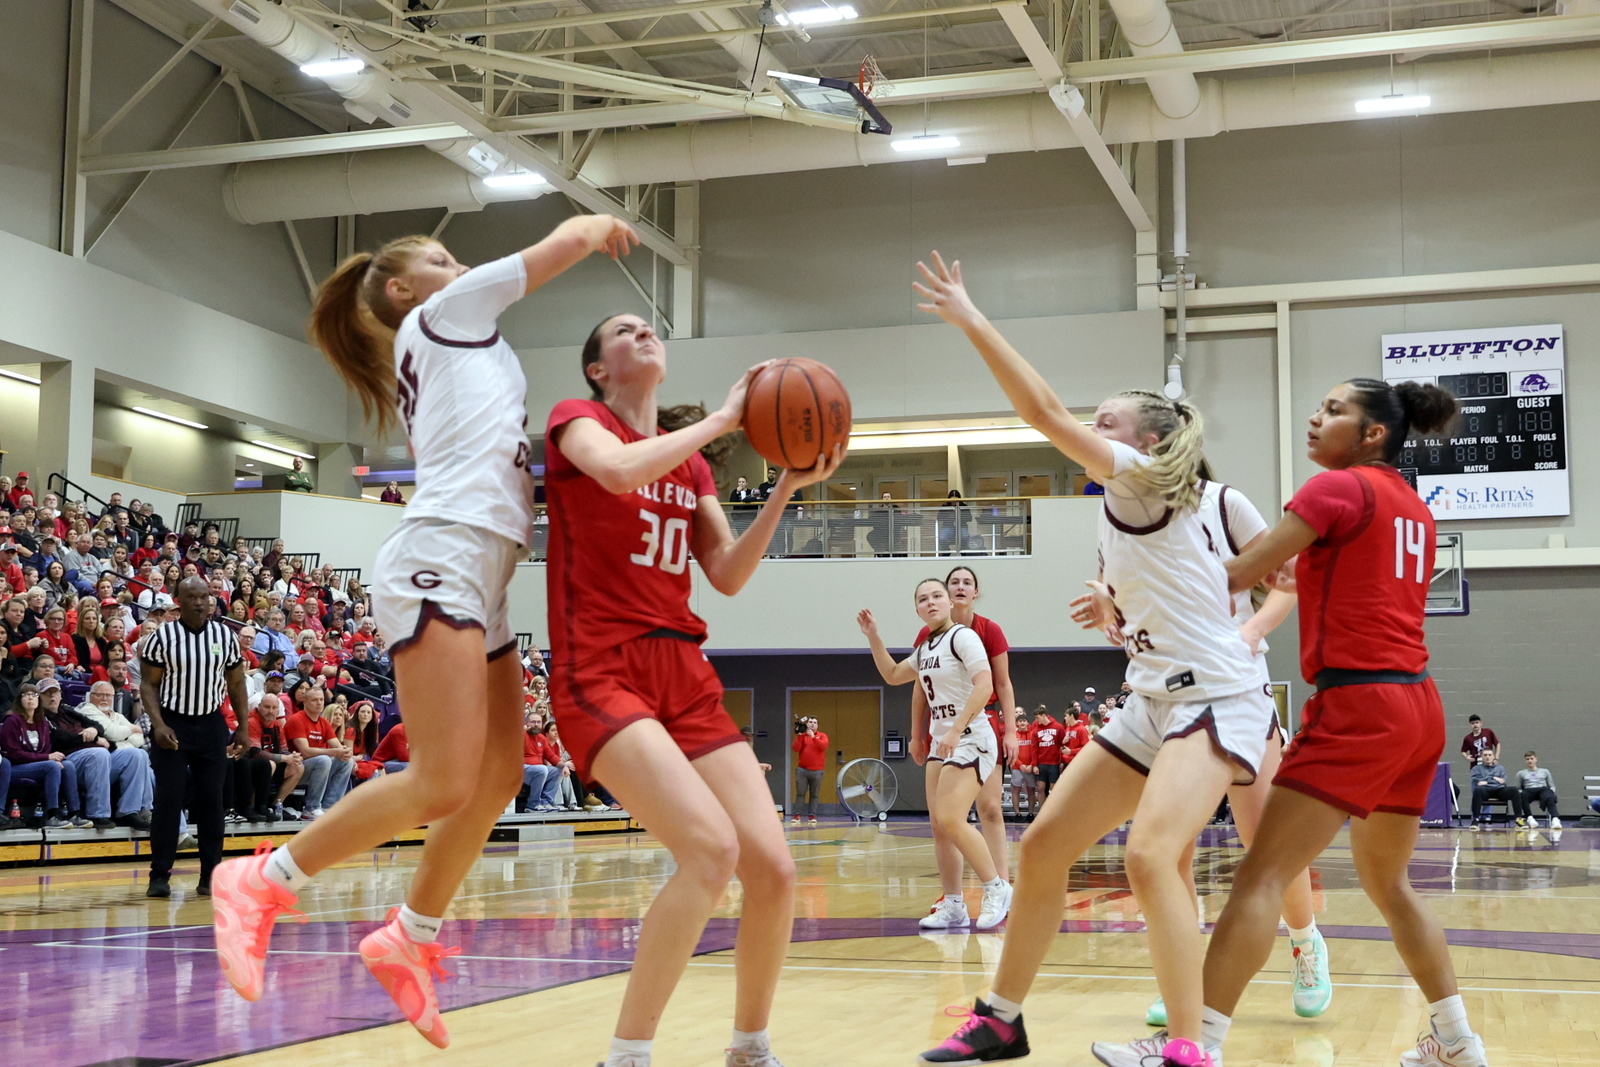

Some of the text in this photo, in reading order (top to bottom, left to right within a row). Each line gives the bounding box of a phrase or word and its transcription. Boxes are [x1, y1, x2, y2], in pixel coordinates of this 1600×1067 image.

[1385, 336, 1560, 360] BLUFFTON
[1395, 351, 1540, 365] UNIVERSITY
[1460, 406, 1487, 415] PERIOD
[1517, 397, 1551, 409] GUEST
[1403, 433, 1557, 448] ULS T.O.L. PLAYER FOUL T.O.L. FOULS
[1463, 462, 1558, 473] MATCH SCORE
[629, 508, 689, 576] 30
[1393, 516, 1426, 585] 14
[411, 570, 443, 590] G
[923, 675, 935, 701] 3
